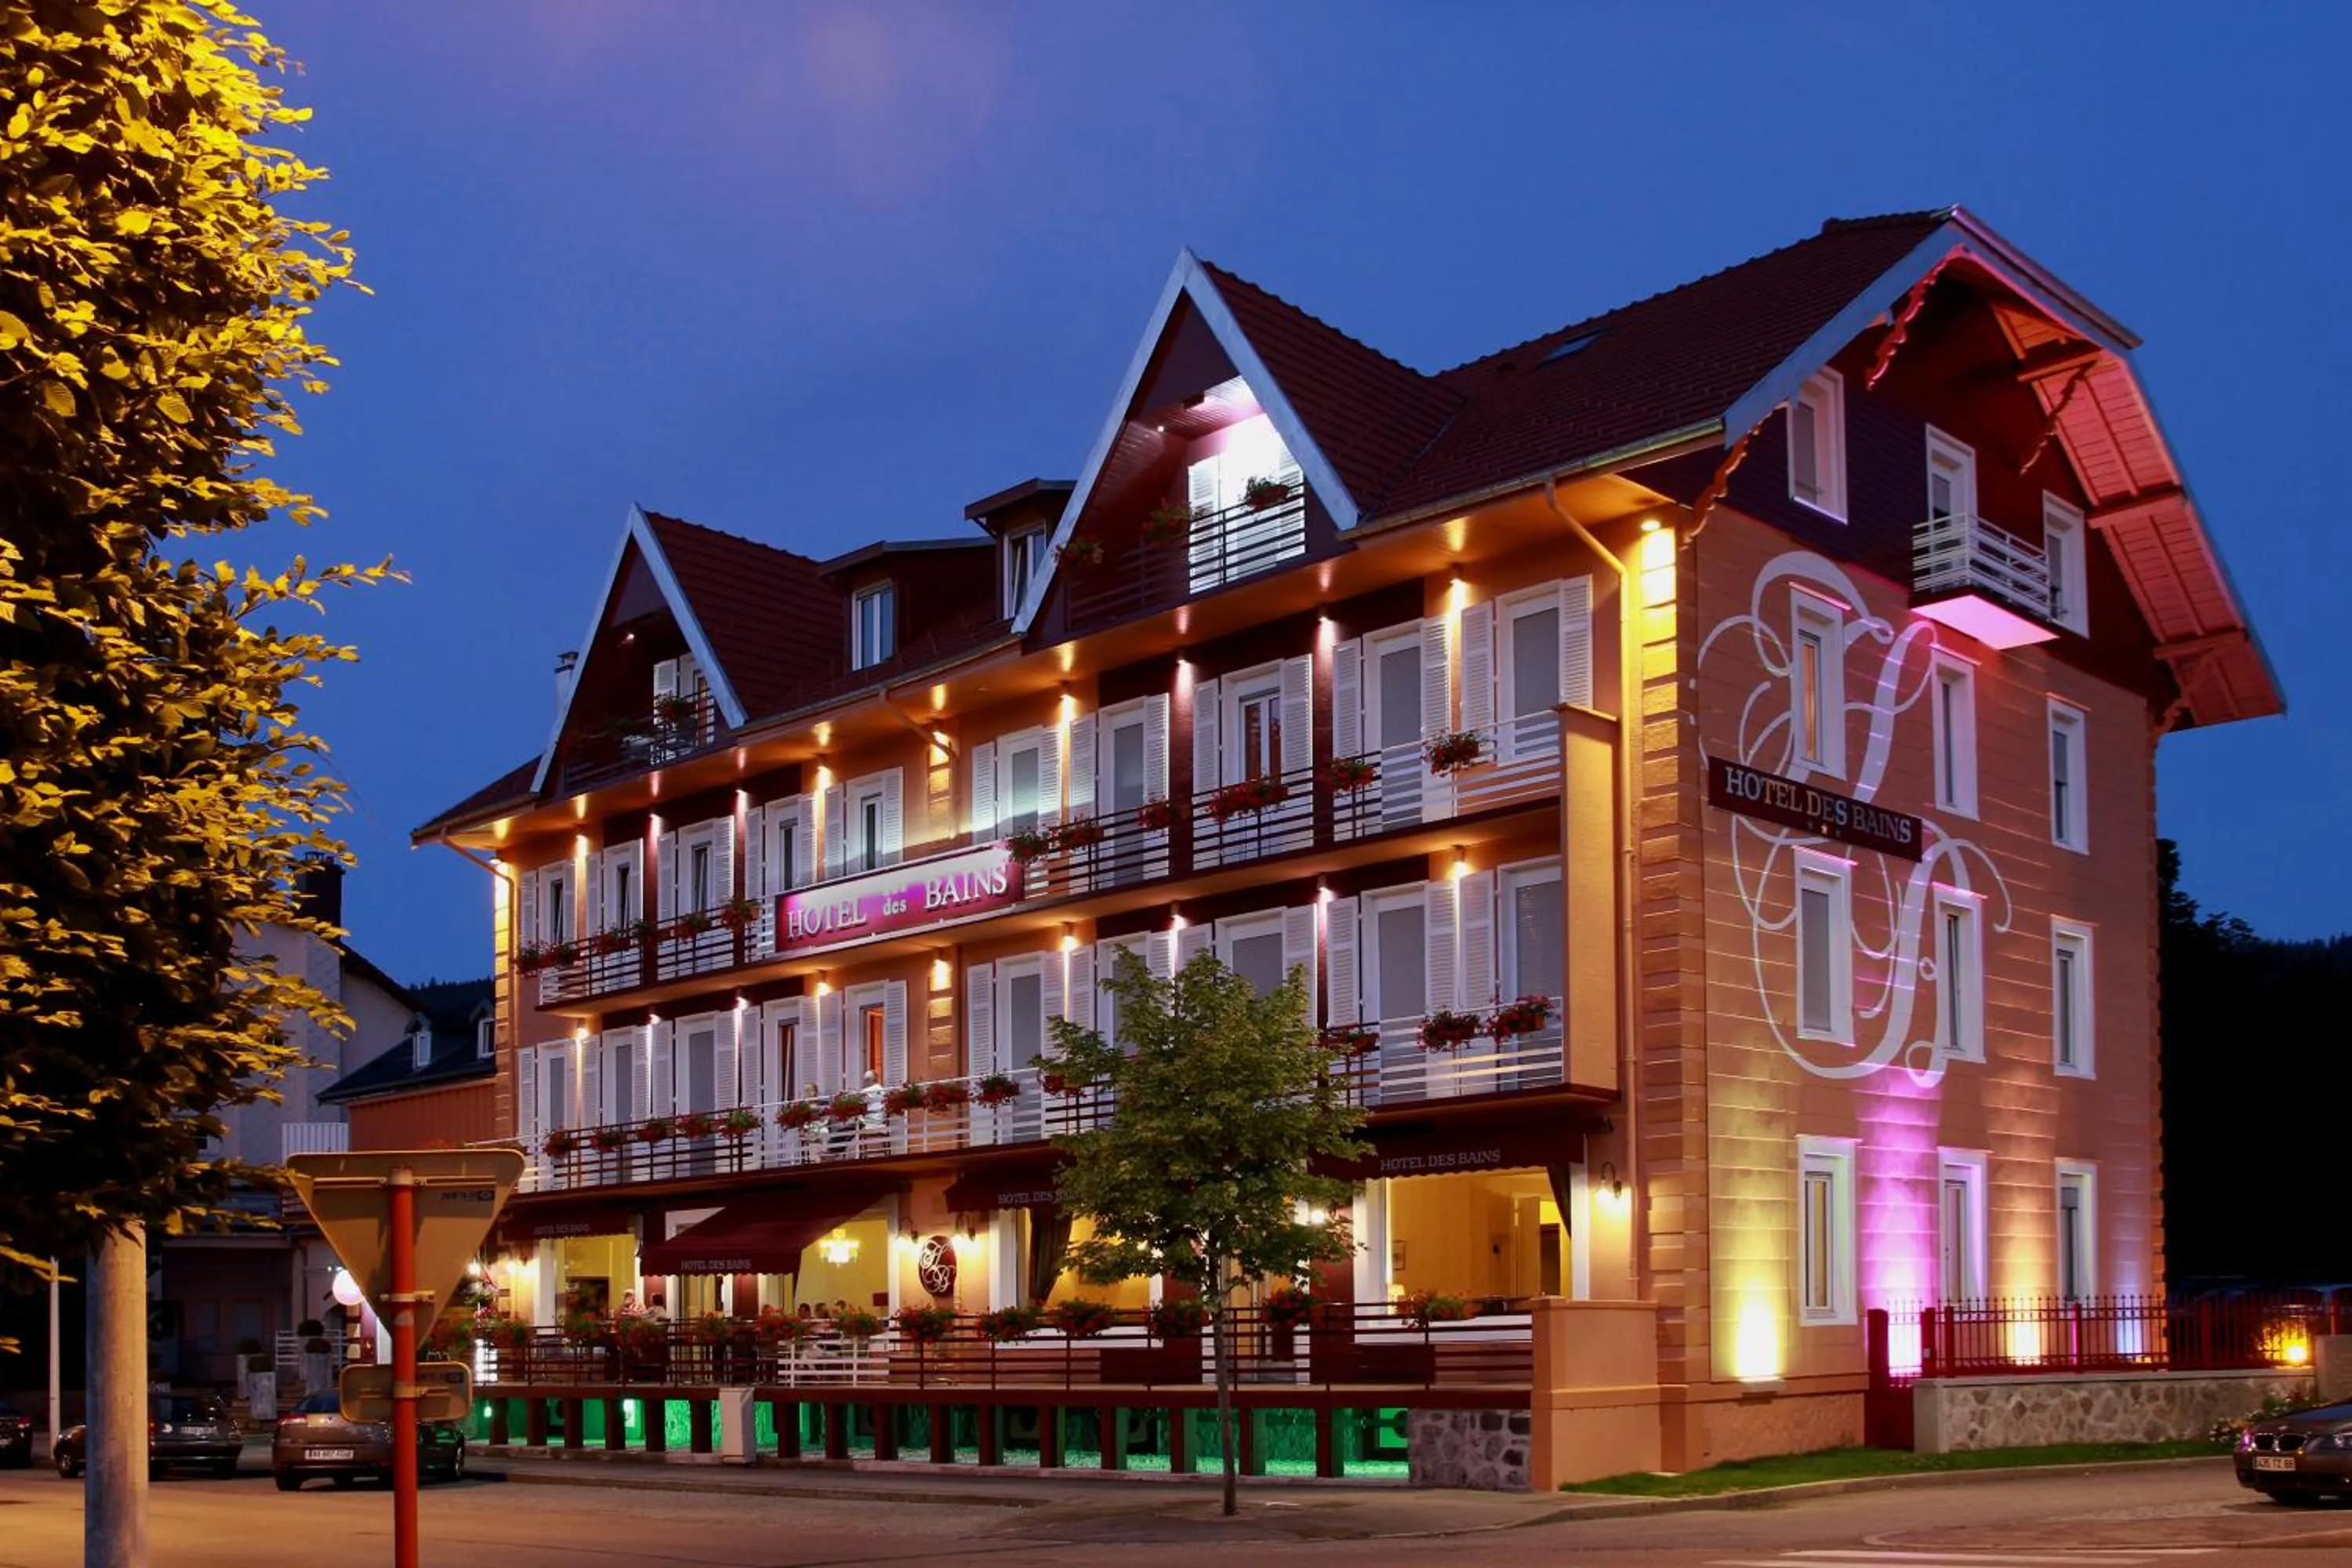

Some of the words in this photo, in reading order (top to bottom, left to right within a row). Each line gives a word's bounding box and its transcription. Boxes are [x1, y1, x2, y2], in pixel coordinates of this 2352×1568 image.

[1725, 766, 1802, 814] HOTEL
[1806, 789, 1848, 826] DES
[1852, 804, 1912, 843] BAINS
[786, 898, 867, 938] HOTEL
[882, 897, 907, 916] des
[924, 863, 1008, 910] BAINS
[1380, 1156, 1426, 1171] HOTEL
[1428, 1153, 1456, 1167] DES
[1458, 1149, 1501, 1164] BAINS
[681, 1259, 706, 1270] HOTEL
[709, 1259, 725, 1269] DES
